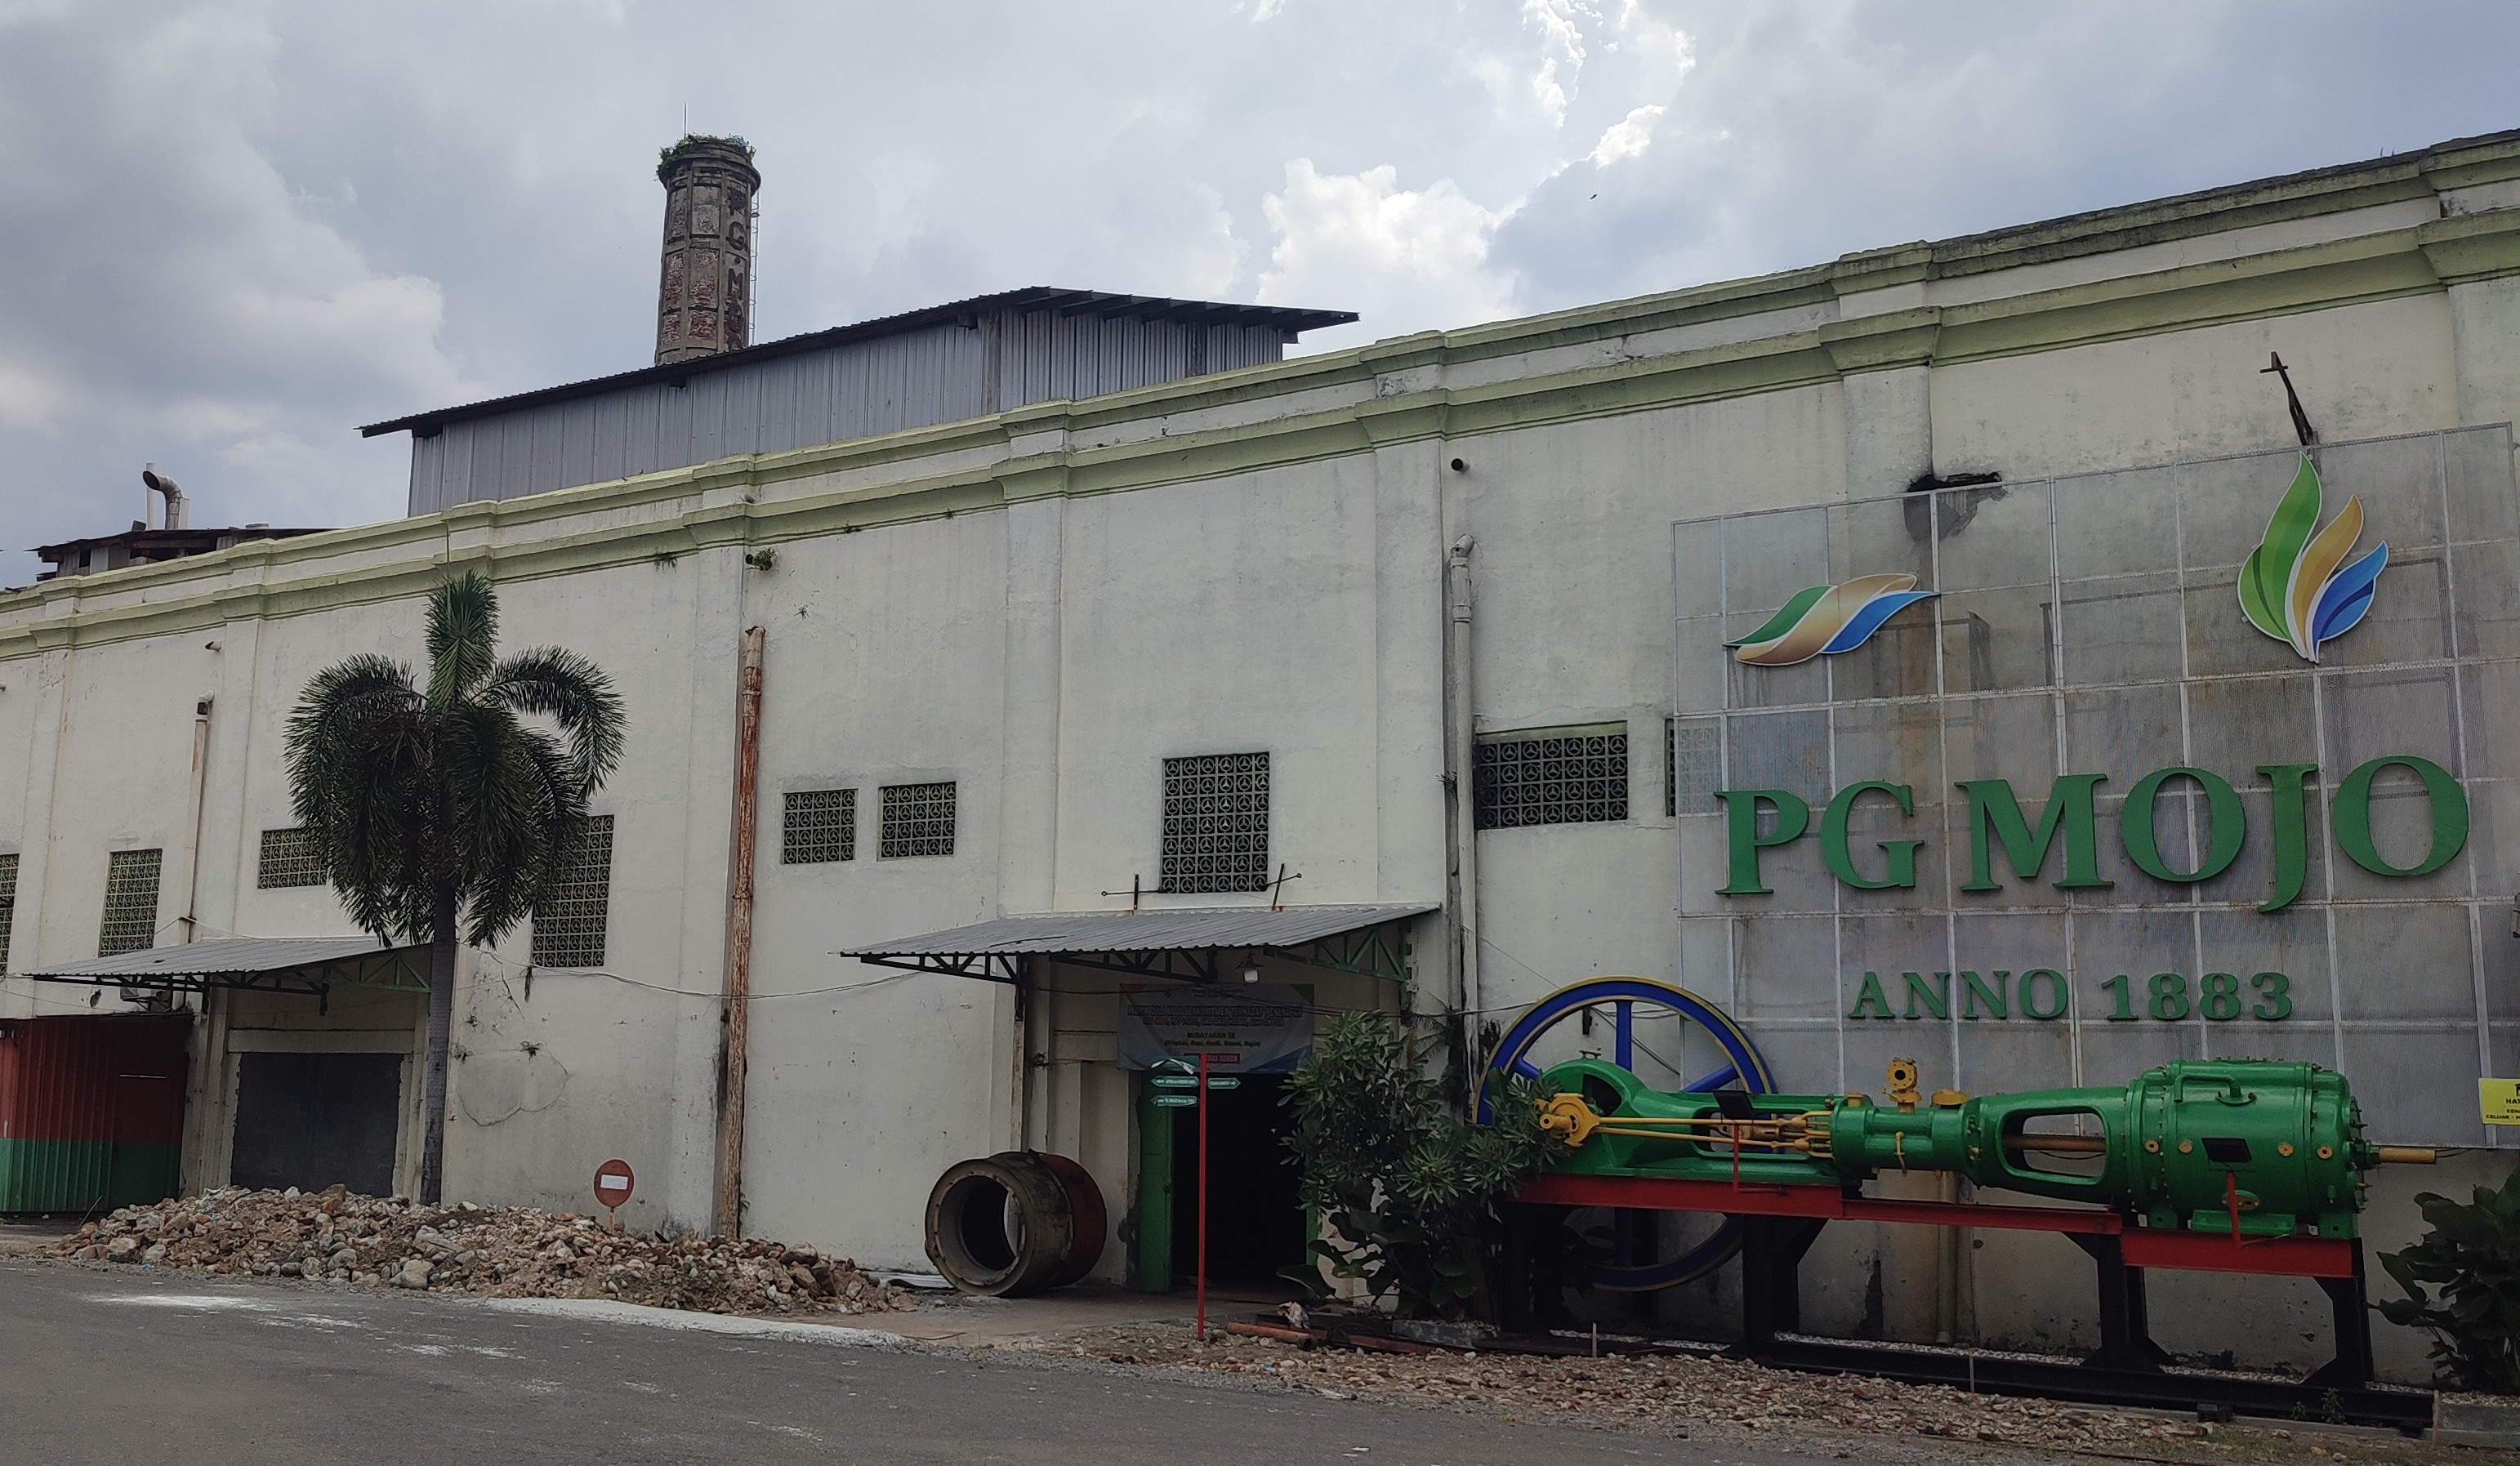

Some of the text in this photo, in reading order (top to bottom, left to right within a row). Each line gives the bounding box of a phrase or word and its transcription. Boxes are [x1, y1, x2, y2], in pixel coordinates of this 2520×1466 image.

[1714, 755, 2469, 913] PG MOJO
[1848, 968, 2293, 1021] ANNO 1883
